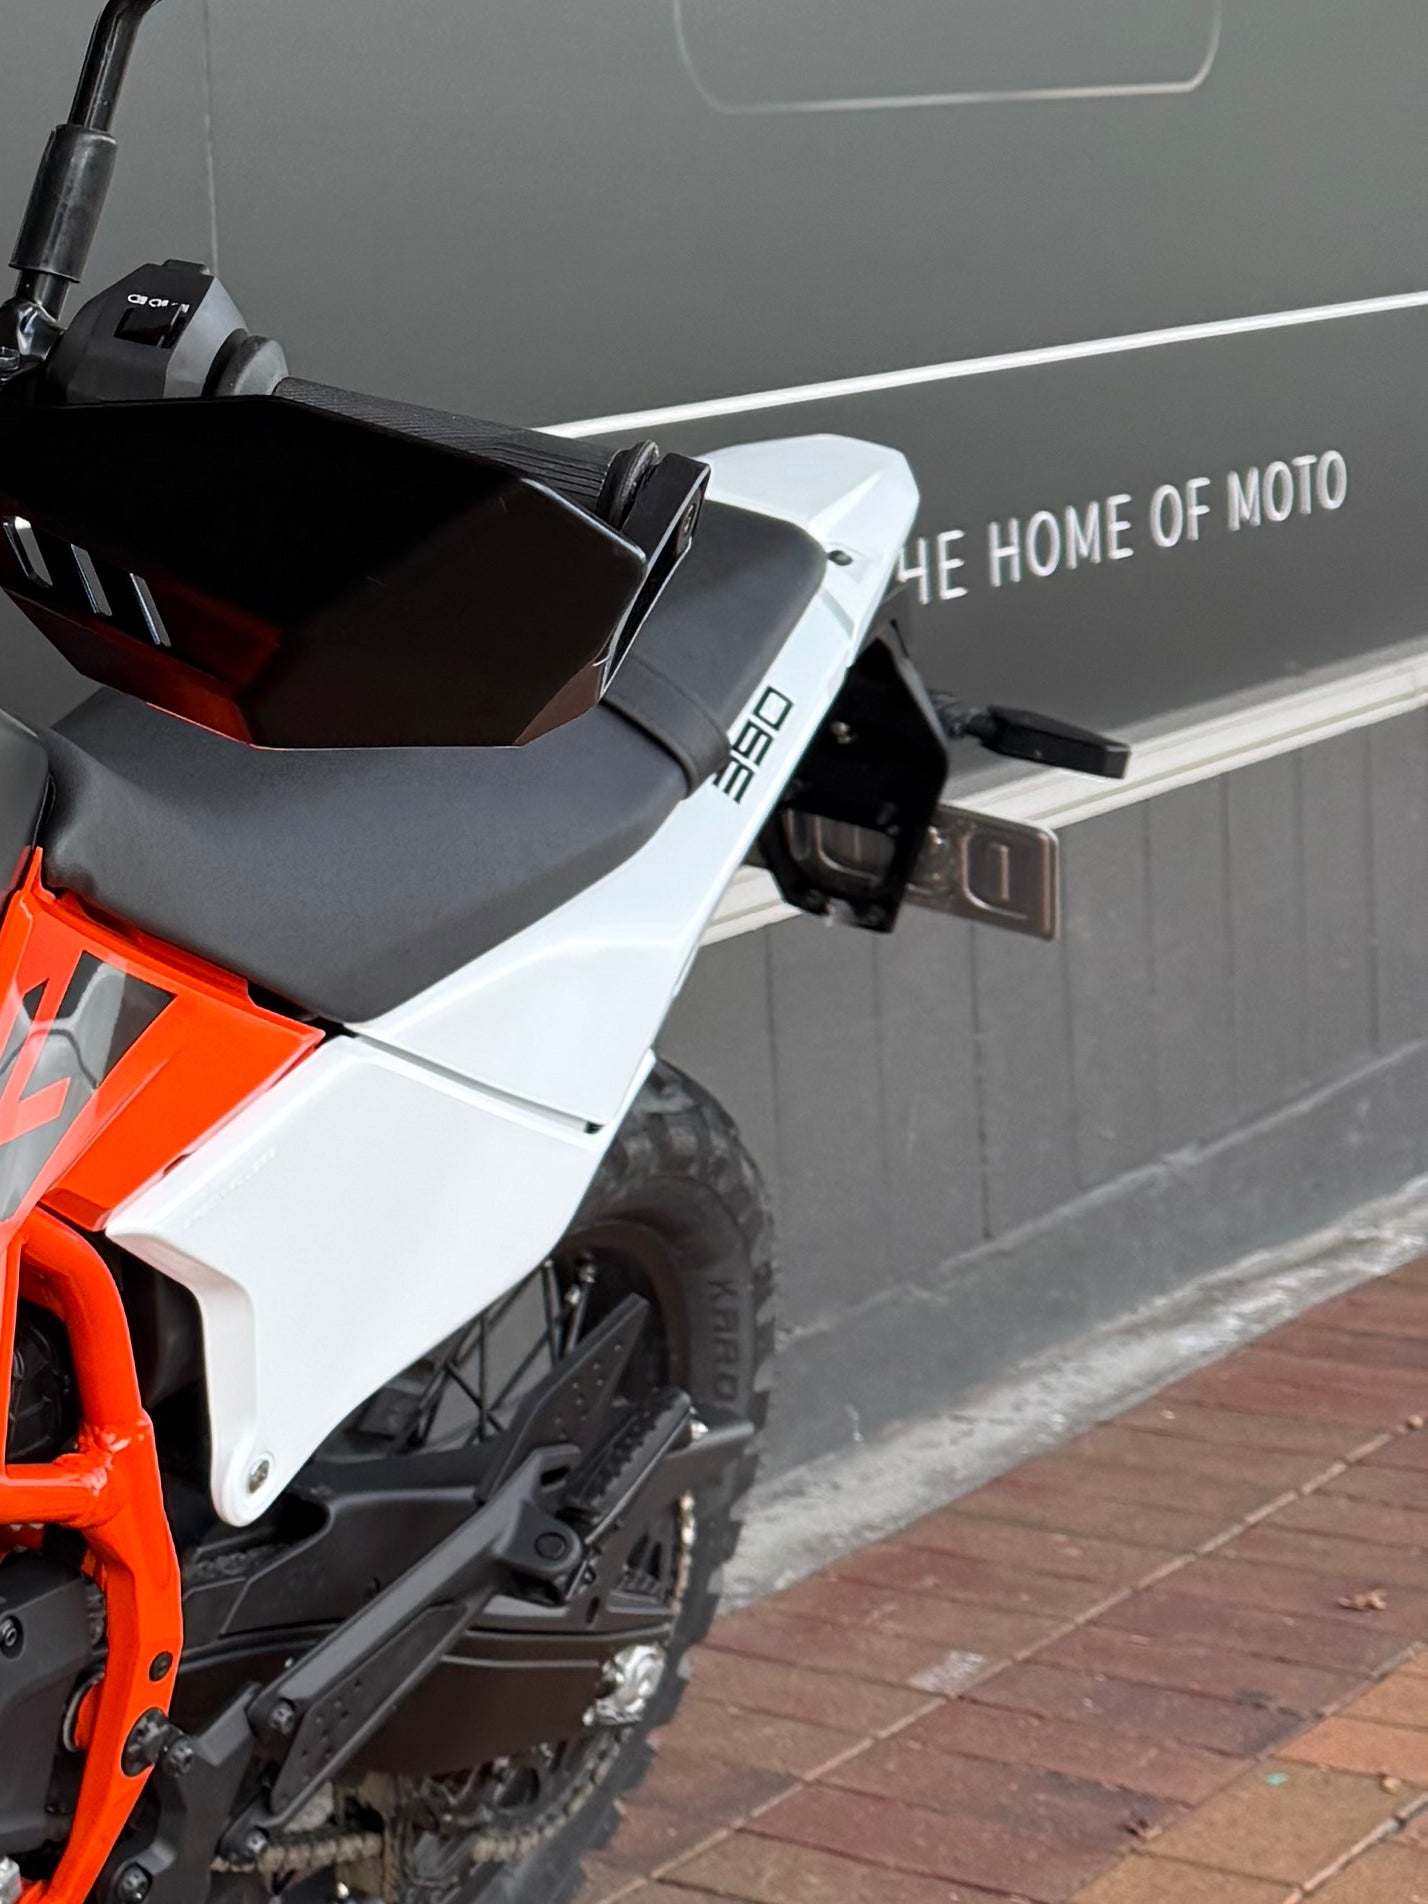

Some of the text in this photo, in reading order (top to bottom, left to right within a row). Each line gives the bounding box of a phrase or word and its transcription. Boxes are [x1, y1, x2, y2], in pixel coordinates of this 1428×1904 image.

[897, 449, 1348, 604] HE HOME OF MOTO
[712, 685, 794, 805] 390
[707, 1280, 740, 1400] KARO
